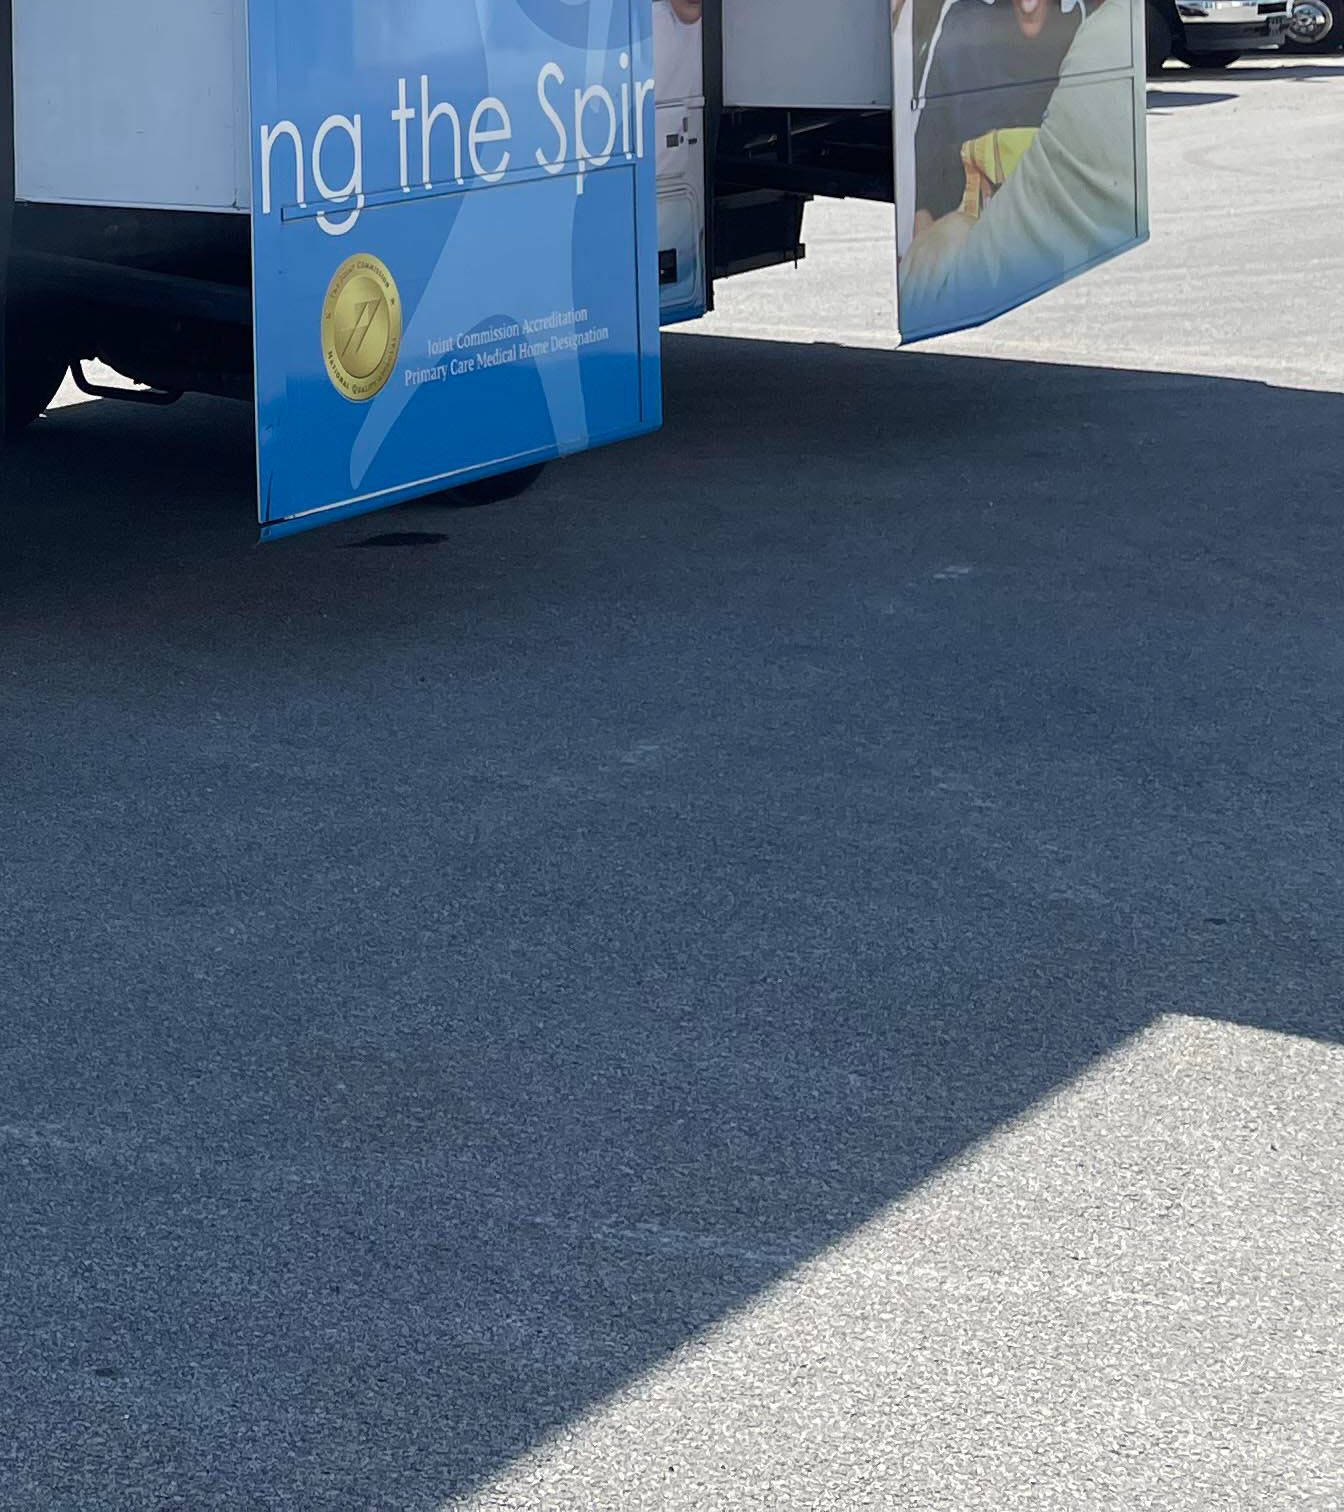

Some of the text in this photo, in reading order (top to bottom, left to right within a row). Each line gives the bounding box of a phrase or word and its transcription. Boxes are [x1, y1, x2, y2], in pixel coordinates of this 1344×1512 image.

[261, 52, 655, 236] ng the Spir
[404, 326, 609, 387] Primary Care Medical Home Designation
[427, 308, 588, 357] Joint Commission Accreditation
